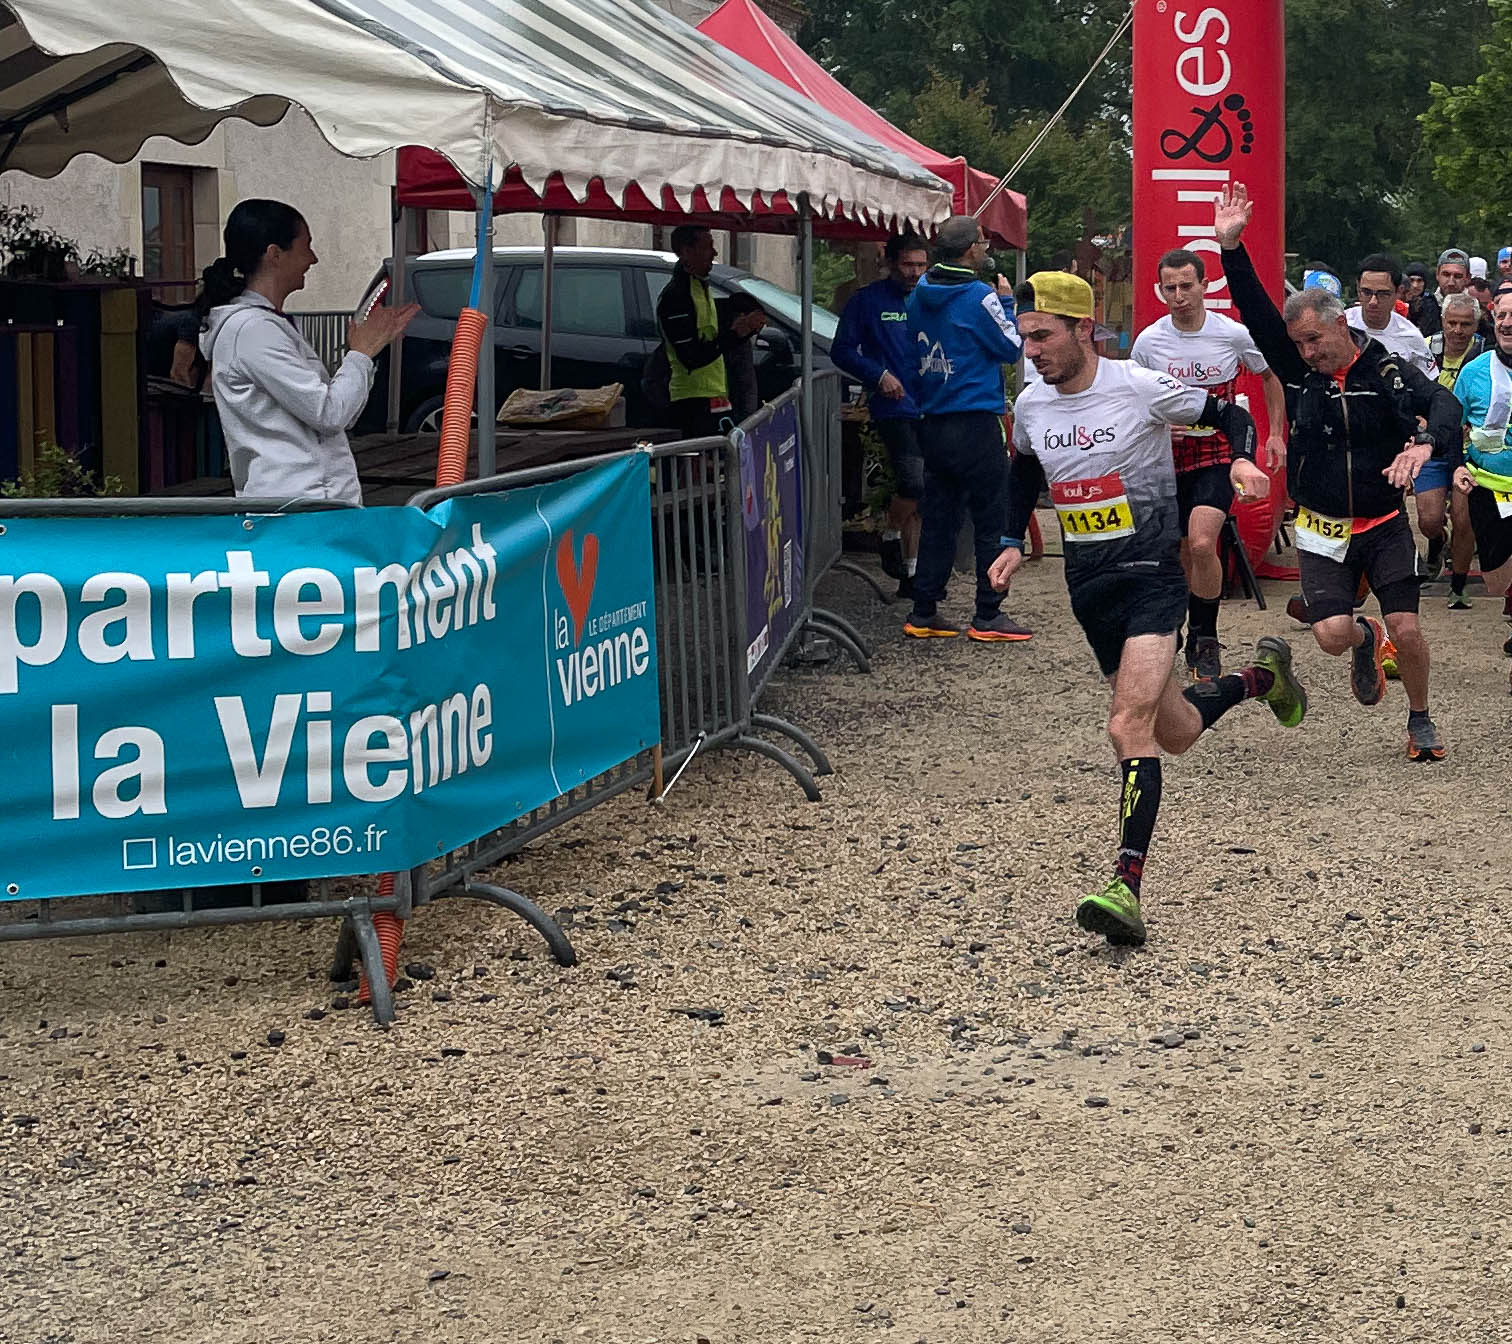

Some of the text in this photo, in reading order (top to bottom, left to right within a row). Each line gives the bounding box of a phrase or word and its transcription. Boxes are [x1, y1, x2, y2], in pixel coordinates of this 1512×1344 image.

[1066, 507, 1121, 532] 1134
[1306, 514, 1344, 538] 1152
[554, 600, 647, 650] la LE DÉPARTEMENT
[556, 626, 649, 707] vienne
[51, 682, 494, 820] la Vienne
[168, 825, 389, 867] lavienne86.fr
